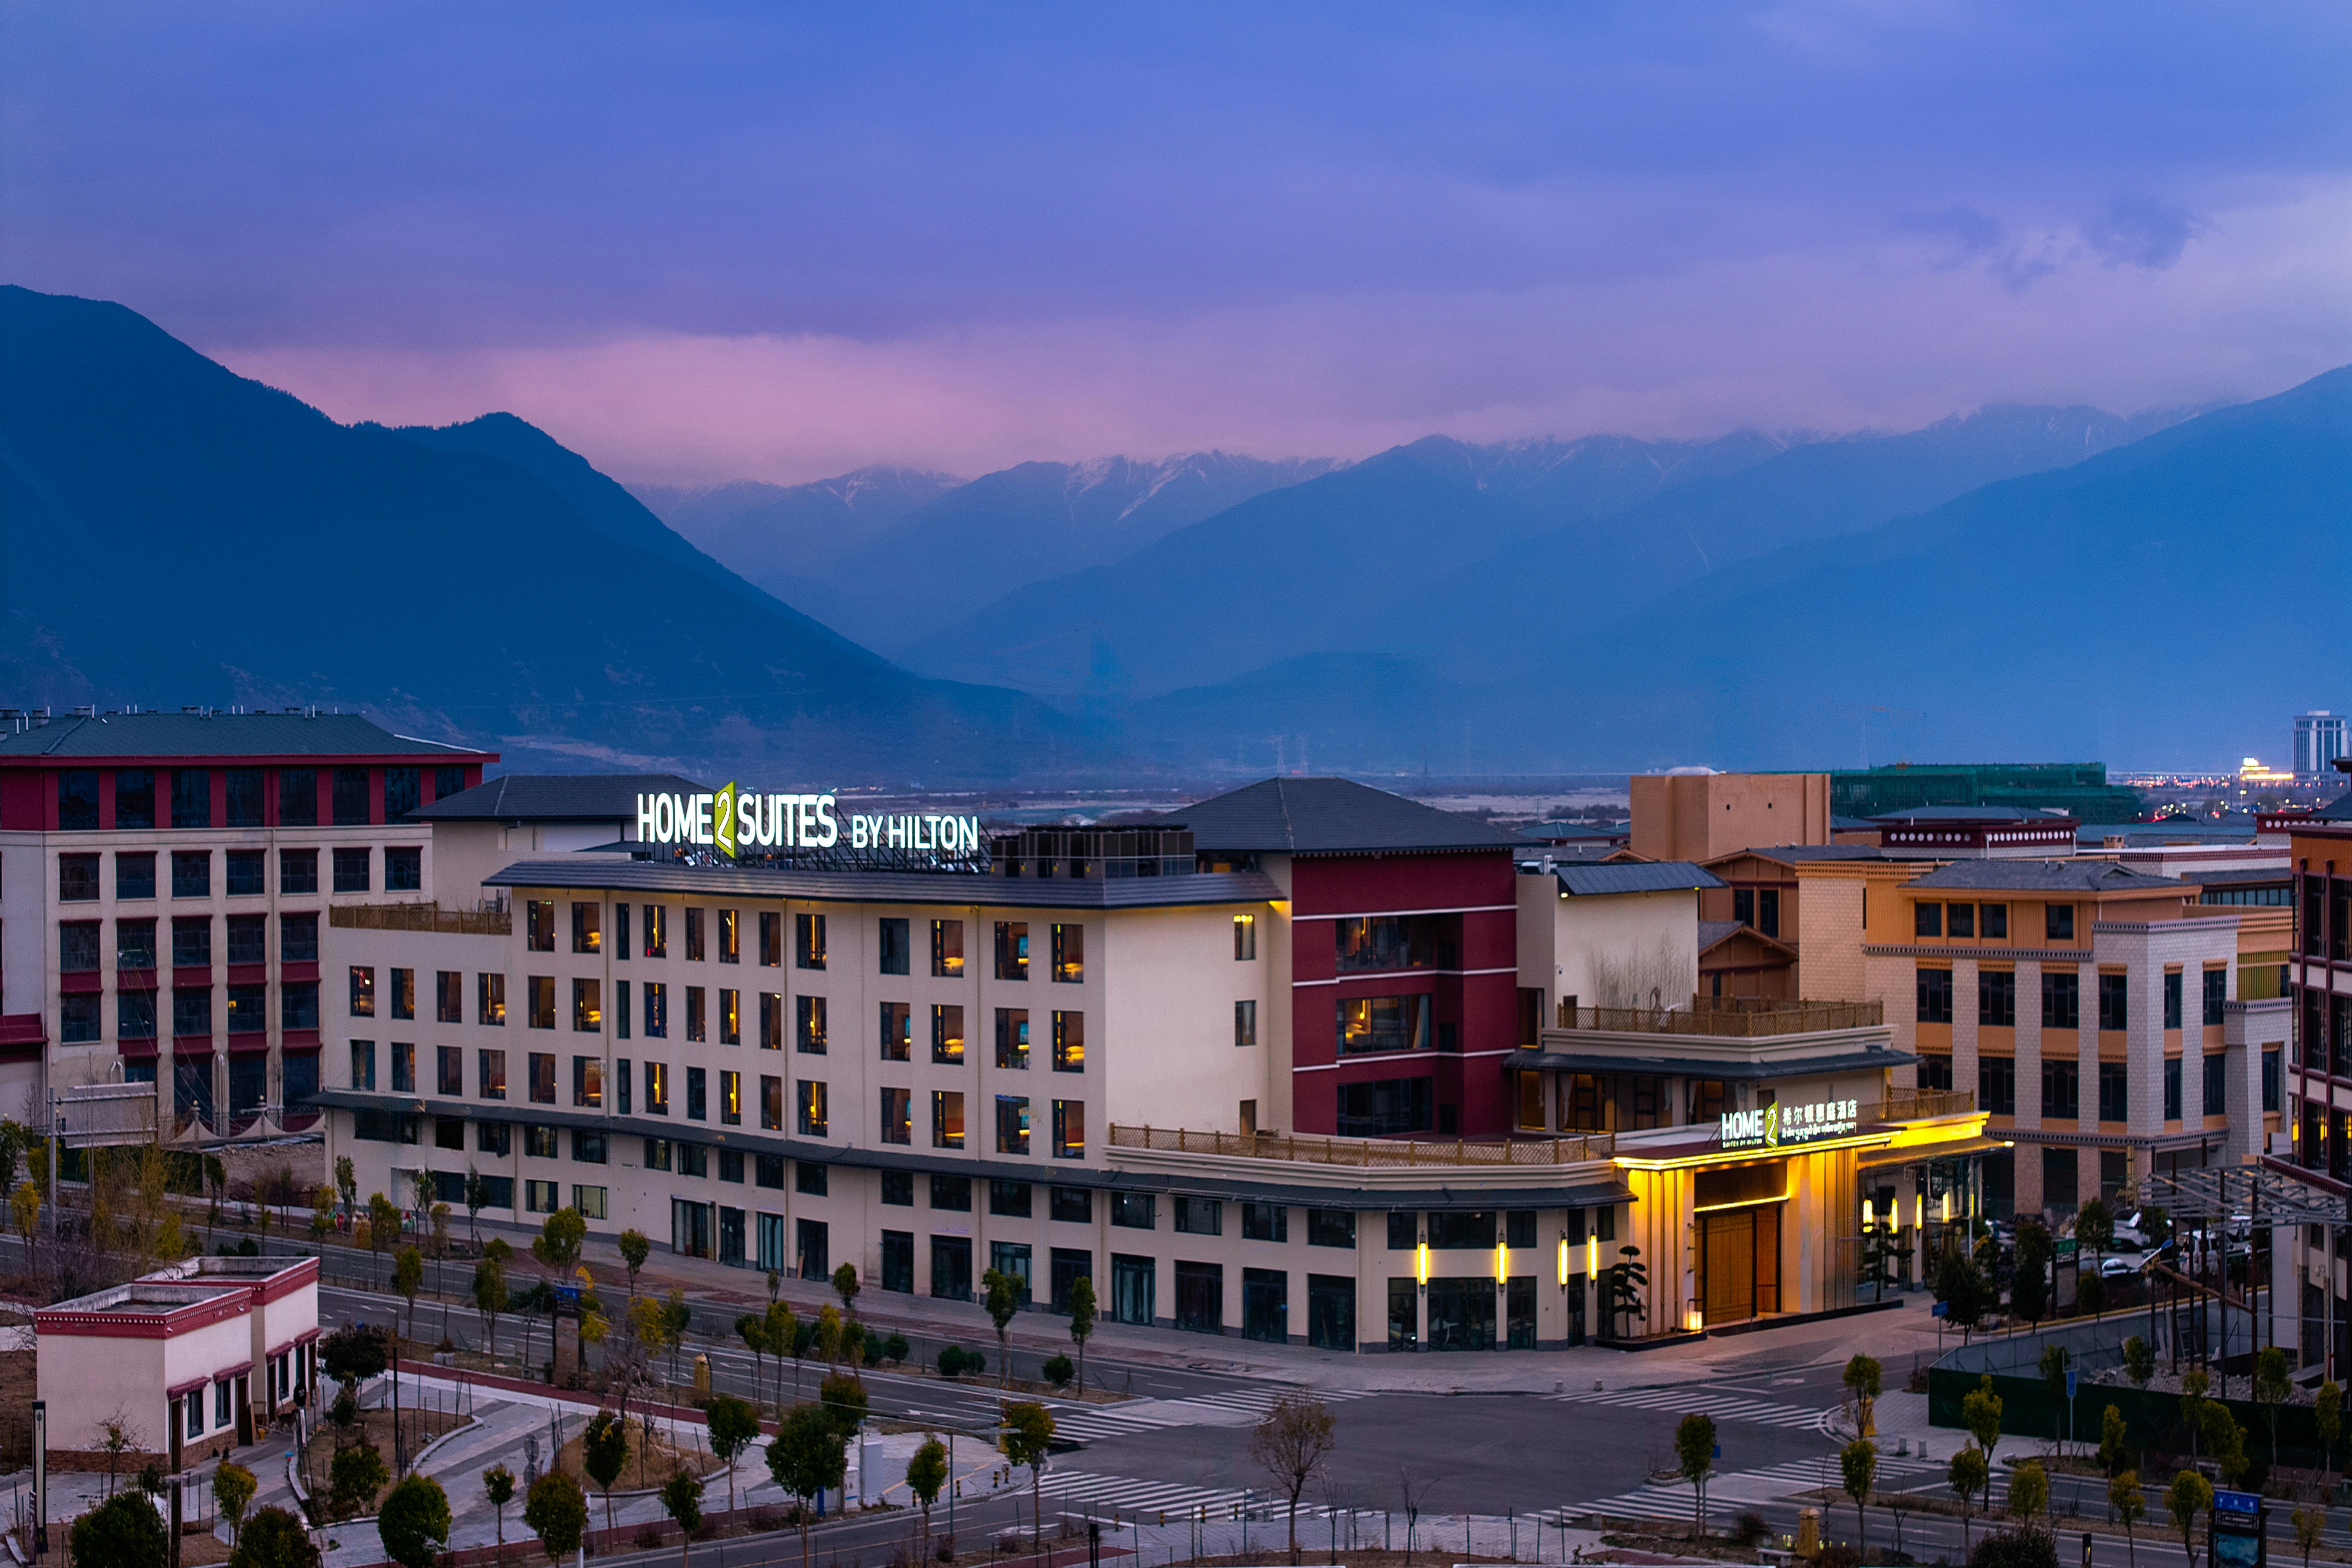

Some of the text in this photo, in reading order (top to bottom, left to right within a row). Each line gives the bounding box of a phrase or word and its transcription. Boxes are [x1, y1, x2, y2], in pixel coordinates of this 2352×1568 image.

[638, 791, 978, 850] HOME 2 SUITES BY HILTON
[1722, 1109, 1764, 1140] HOME
[1767, 1108, 1777, 1145] 2
[1782, 1098, 1858, 1126] 希尔顿惠庭酒店
